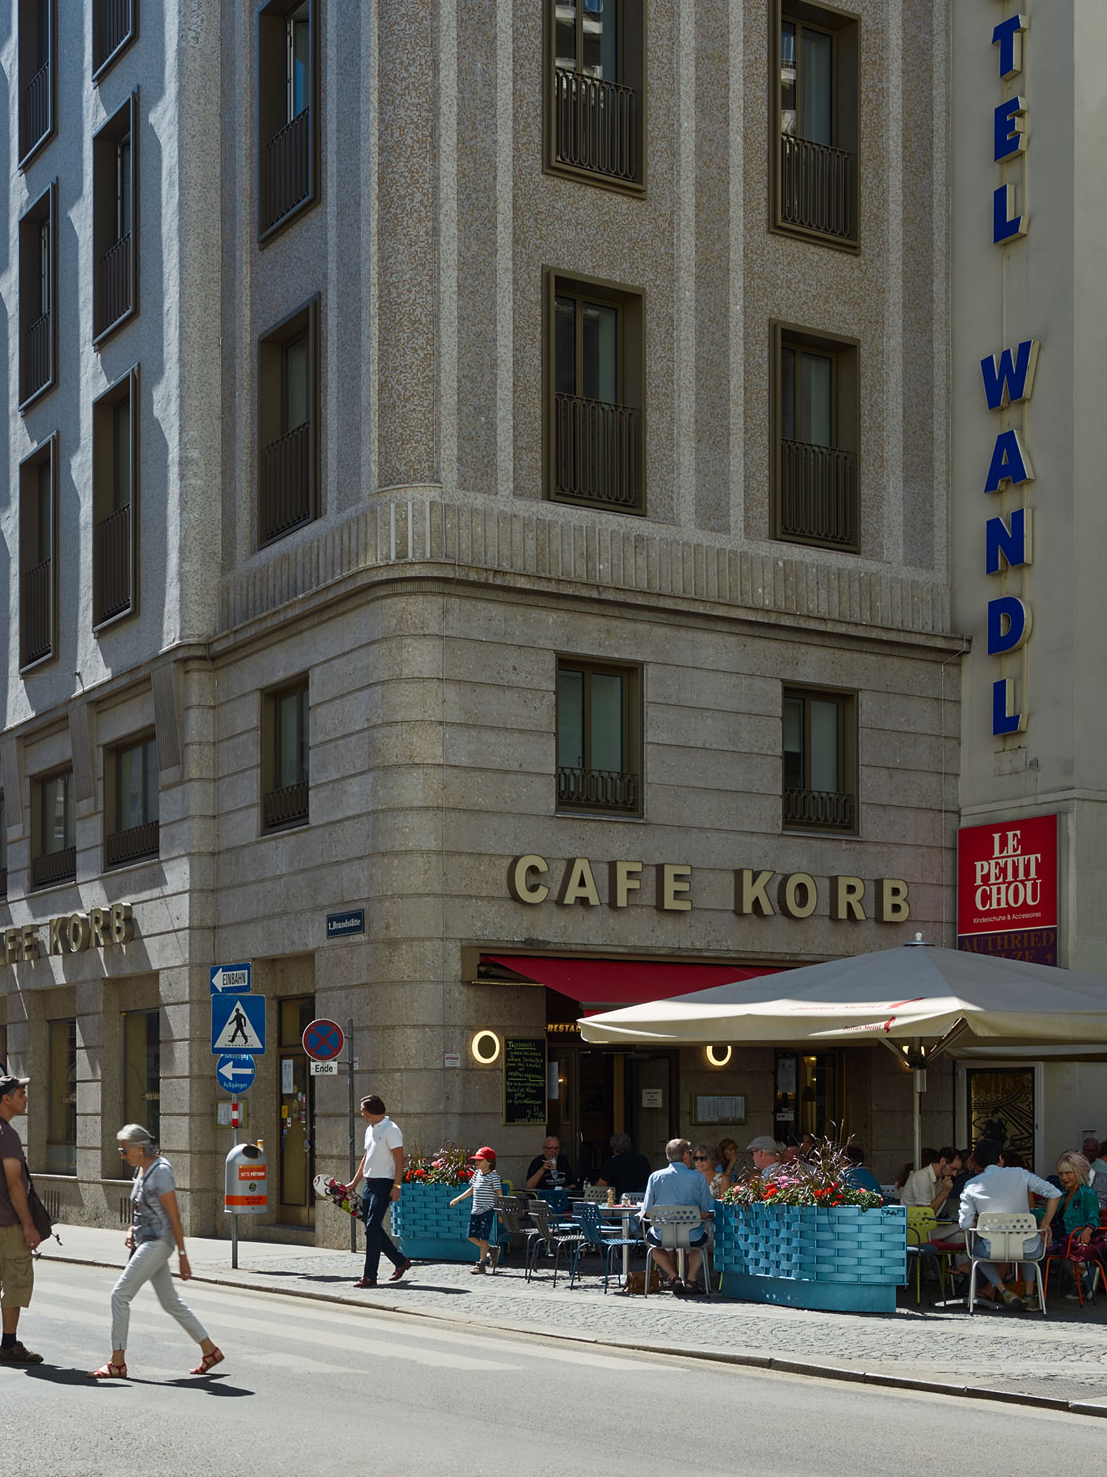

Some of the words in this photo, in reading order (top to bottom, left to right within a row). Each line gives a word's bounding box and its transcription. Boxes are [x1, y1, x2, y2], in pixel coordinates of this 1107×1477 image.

[980, 339, 1039, 736] WANDL
[992, 830, 1021, 858] LE
[974, 853, 1042, 886] PETIT
[508, 853, 692, 912] CAFE
[736, 868, 911, 923] KORB
[975, 879, 1042, 911] CHOU
[49, 902, 134, 956] KORB
[973, 914, 1006, 924] Kinderschuhe
[1012, 912, 1042, 920] Accessoires
[222, 971, 246, 986] EINBAHN
[315, 1064, 334, 1073] Ende
[223, 1081, 248, 1090] Fußgänger
